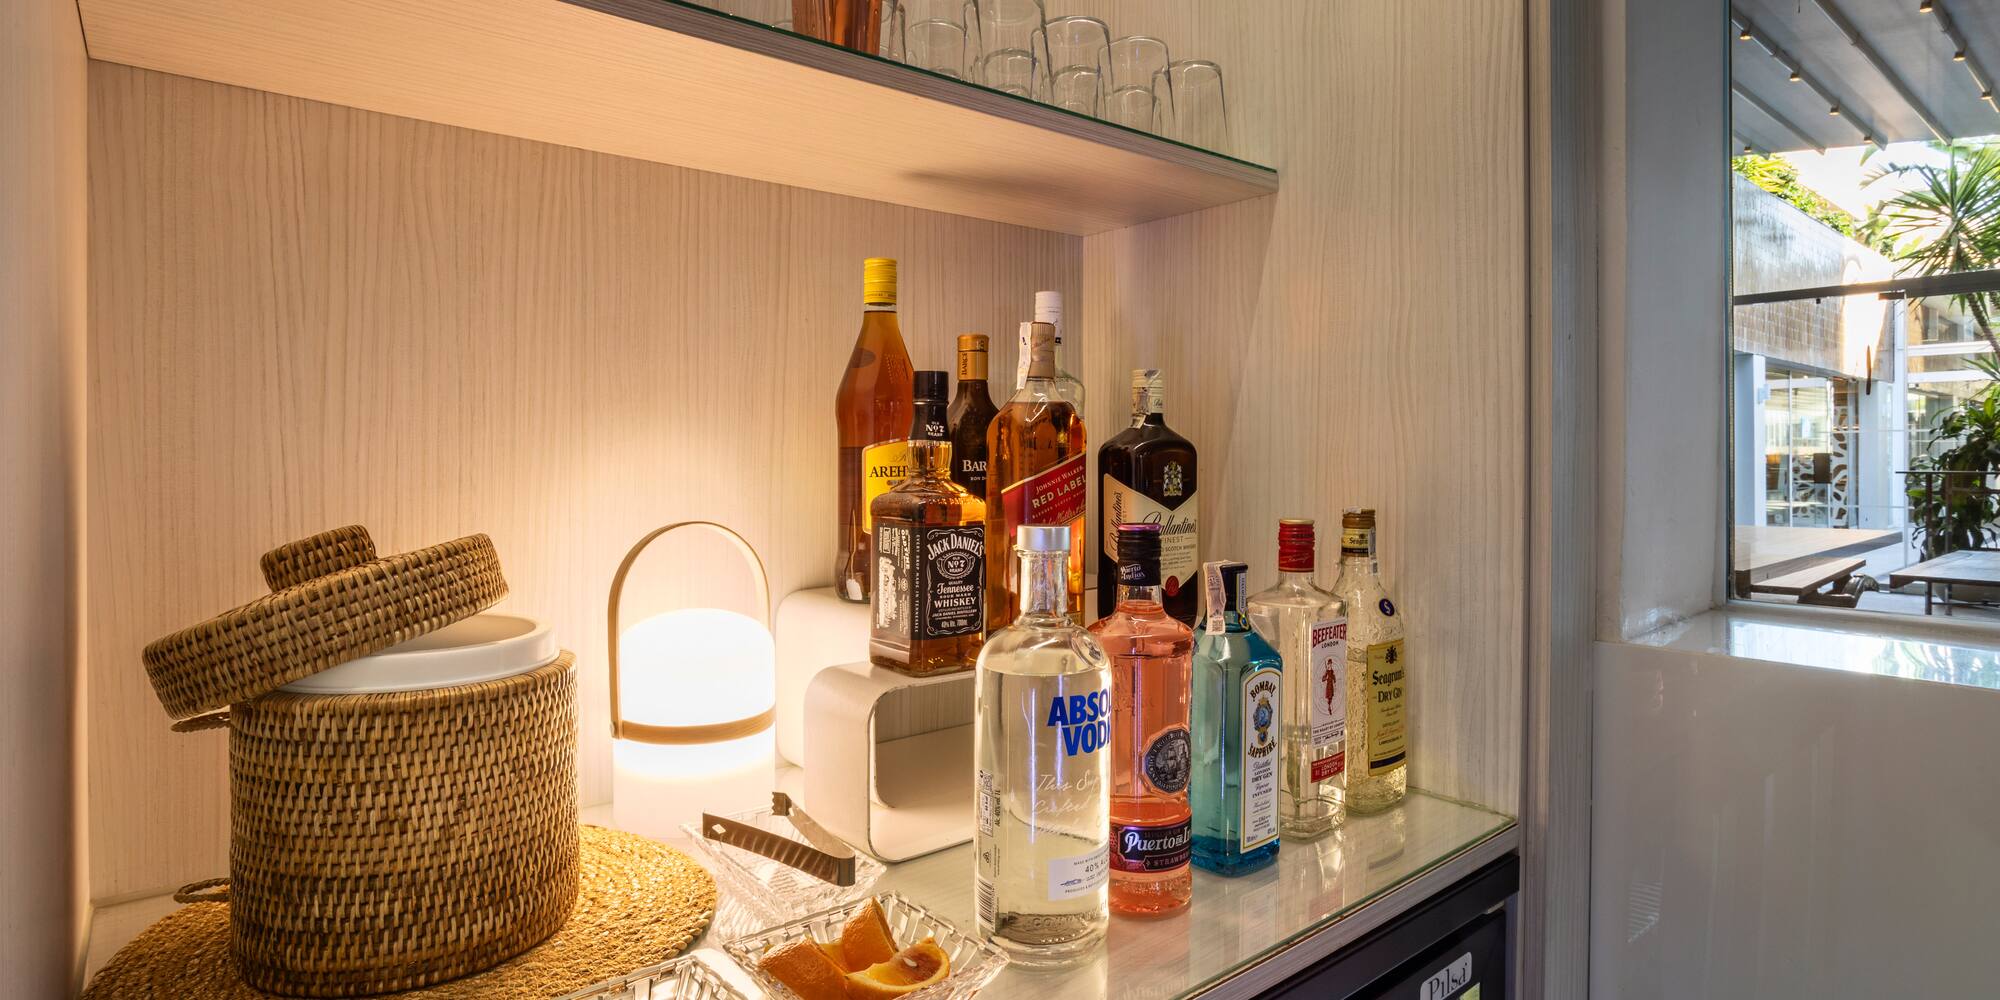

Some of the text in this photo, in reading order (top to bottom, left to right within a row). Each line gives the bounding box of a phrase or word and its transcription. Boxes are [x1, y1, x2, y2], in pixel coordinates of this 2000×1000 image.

[869, 465, 908, 477] AREH
[1032, 475, 1086, 509] RED LABEL
[926, 537, 950, 560] JACK
[950, 533, 984, 558] DANIEL'S
[936, 582, 974, 595] Tennessee
[934, 596, 976, 608] WHISKEY
[1312, 623, 1347, 648] BEEFEATER
[1321, 641, 1339, 649] LONDON
[1372, 666, 1405, 686] Seagram's
[1250, 681, 1276, 702] BOMBAY
[1377, 687, 1402, 703] DRY GIN
[1047, 688, 1110, 727] ABSO
[1062, 717, 1109, 756] VOD
[1248, 736, 1277, 758] SAPPHIRE
[1124, 831, 1175, 853] Puerto
